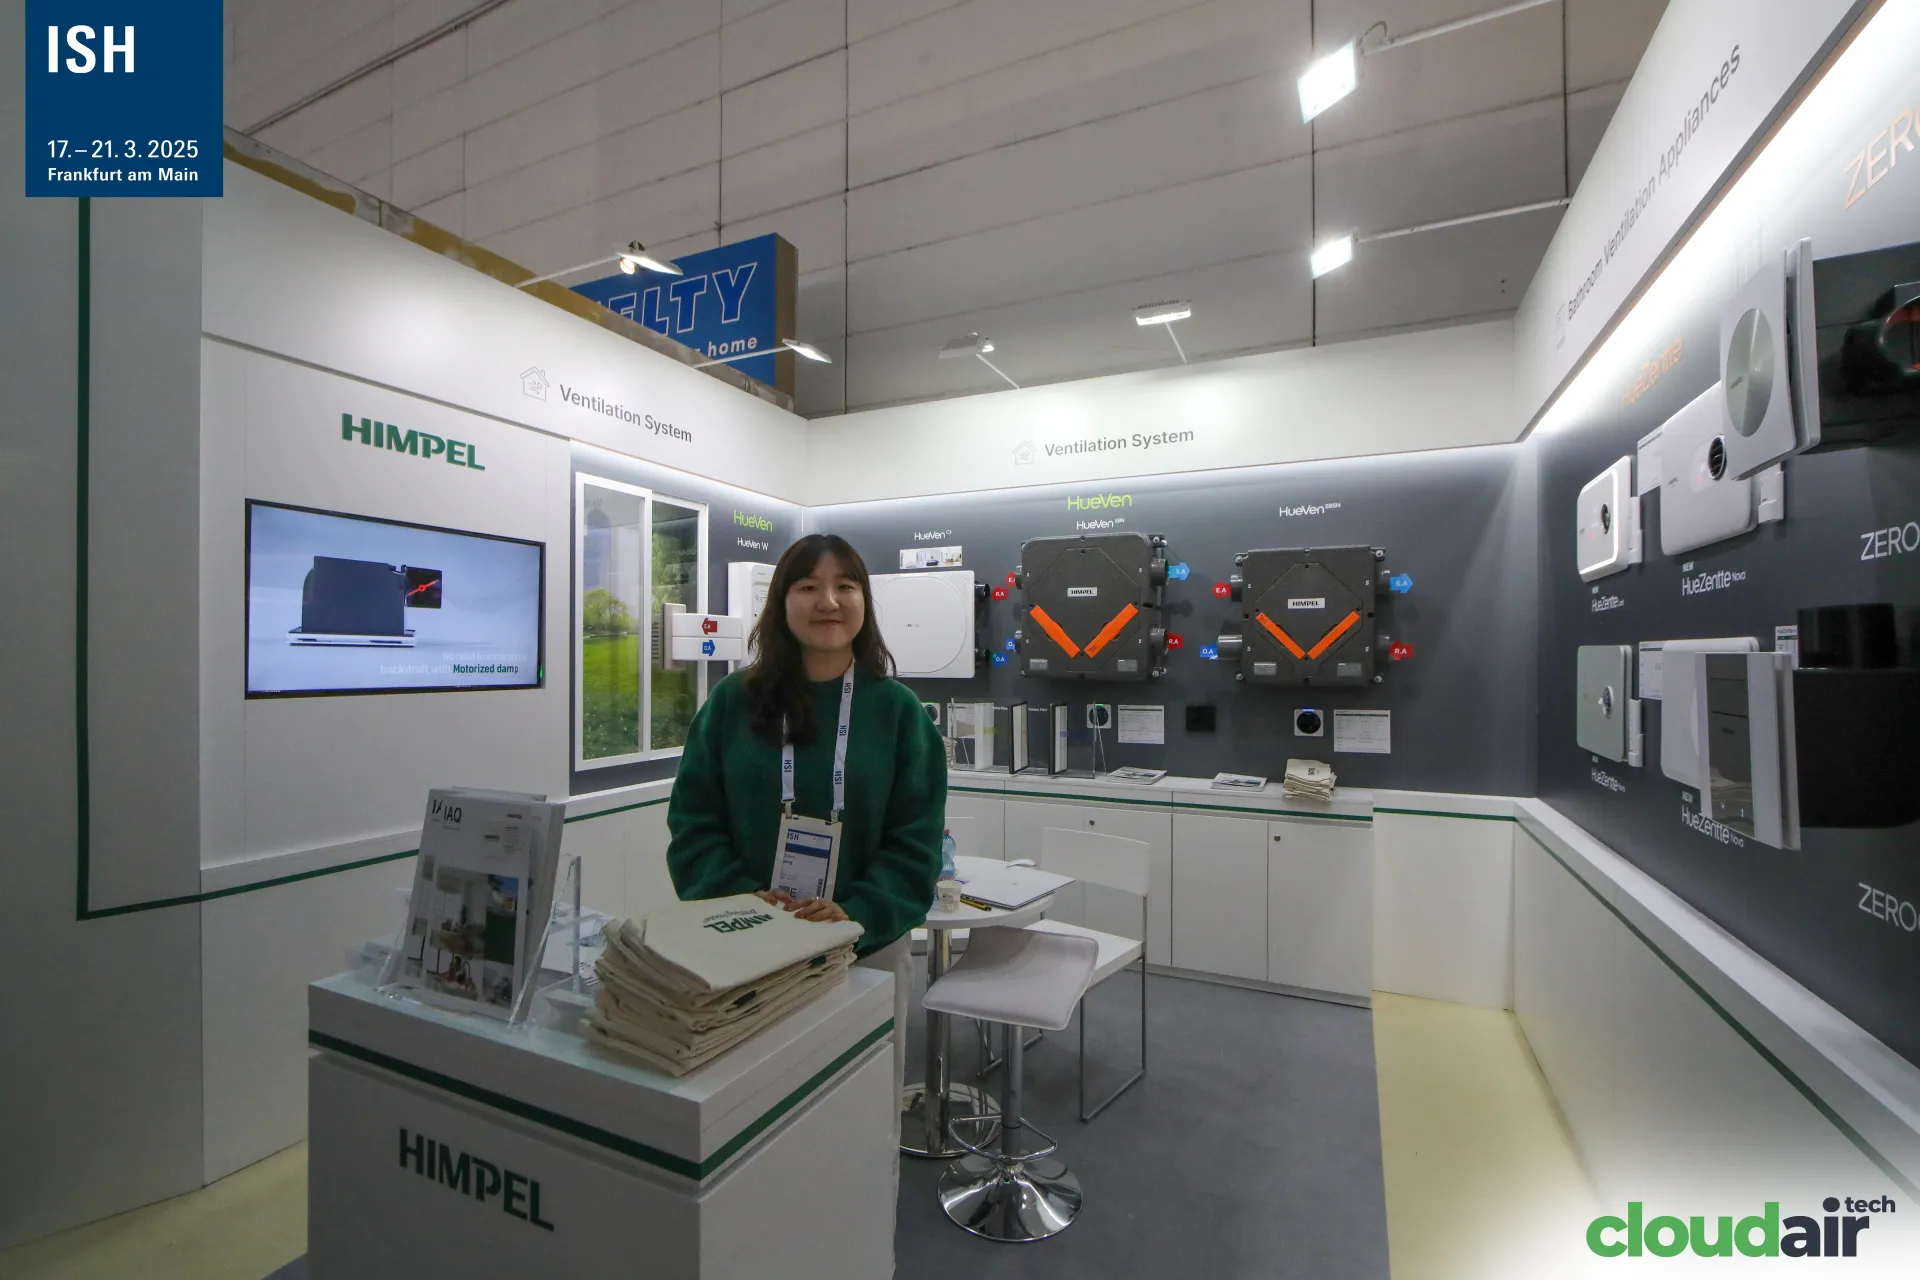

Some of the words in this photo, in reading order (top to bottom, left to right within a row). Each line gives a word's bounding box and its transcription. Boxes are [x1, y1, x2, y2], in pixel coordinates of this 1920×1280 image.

[1568, 257, 1604, 322] Bathroom
[1603, 173, 1656, 265] Ventilation
[1658, 43, 1741, 186] Appliances
[707, 336, 758, 357] home
[559, 384, 641, 427] Ventilation
[644, 415, 693, 443] System
[341, 413, 486, 471] HIMPEL
[1044, 435, 1128, 458] Ventilation
[1131, 428, 1195, 452] System
[1067, 493, 1133, 511] HueVen
[1279, 504, 1325, 517] HueVen
[733, 510, 773, 533] HueVen
[1076, 519, 1114, 530] HueVen
[737, 536, 761, 550] HueVen
[761, 542, 769, 551] W
[913, 531, 946, 541] HueVen
[1860, 521, 1920, 561] ZERO
[1681, 569, 1732, 597] HueZentte
[1292, 600, 1320, 608] HIMPEL
[452, 663, 495, 674] Motorized
[496, 663, 519, 675] damp
[843, 682, 852, 694] ISH
[839, 725, 848, 737] ISH
[784, 759, 792, 773] ISH
[834, 770, 843, 785] ISH
[443, 805, 463, 823] IAQ
[1681, 806, 1730, 845] HueZentte
[787, 832, 800, 841] ISH
[1858, 882, 1920, 932] ZERO
[399, 1126, 555, 1232] HIMPEL
